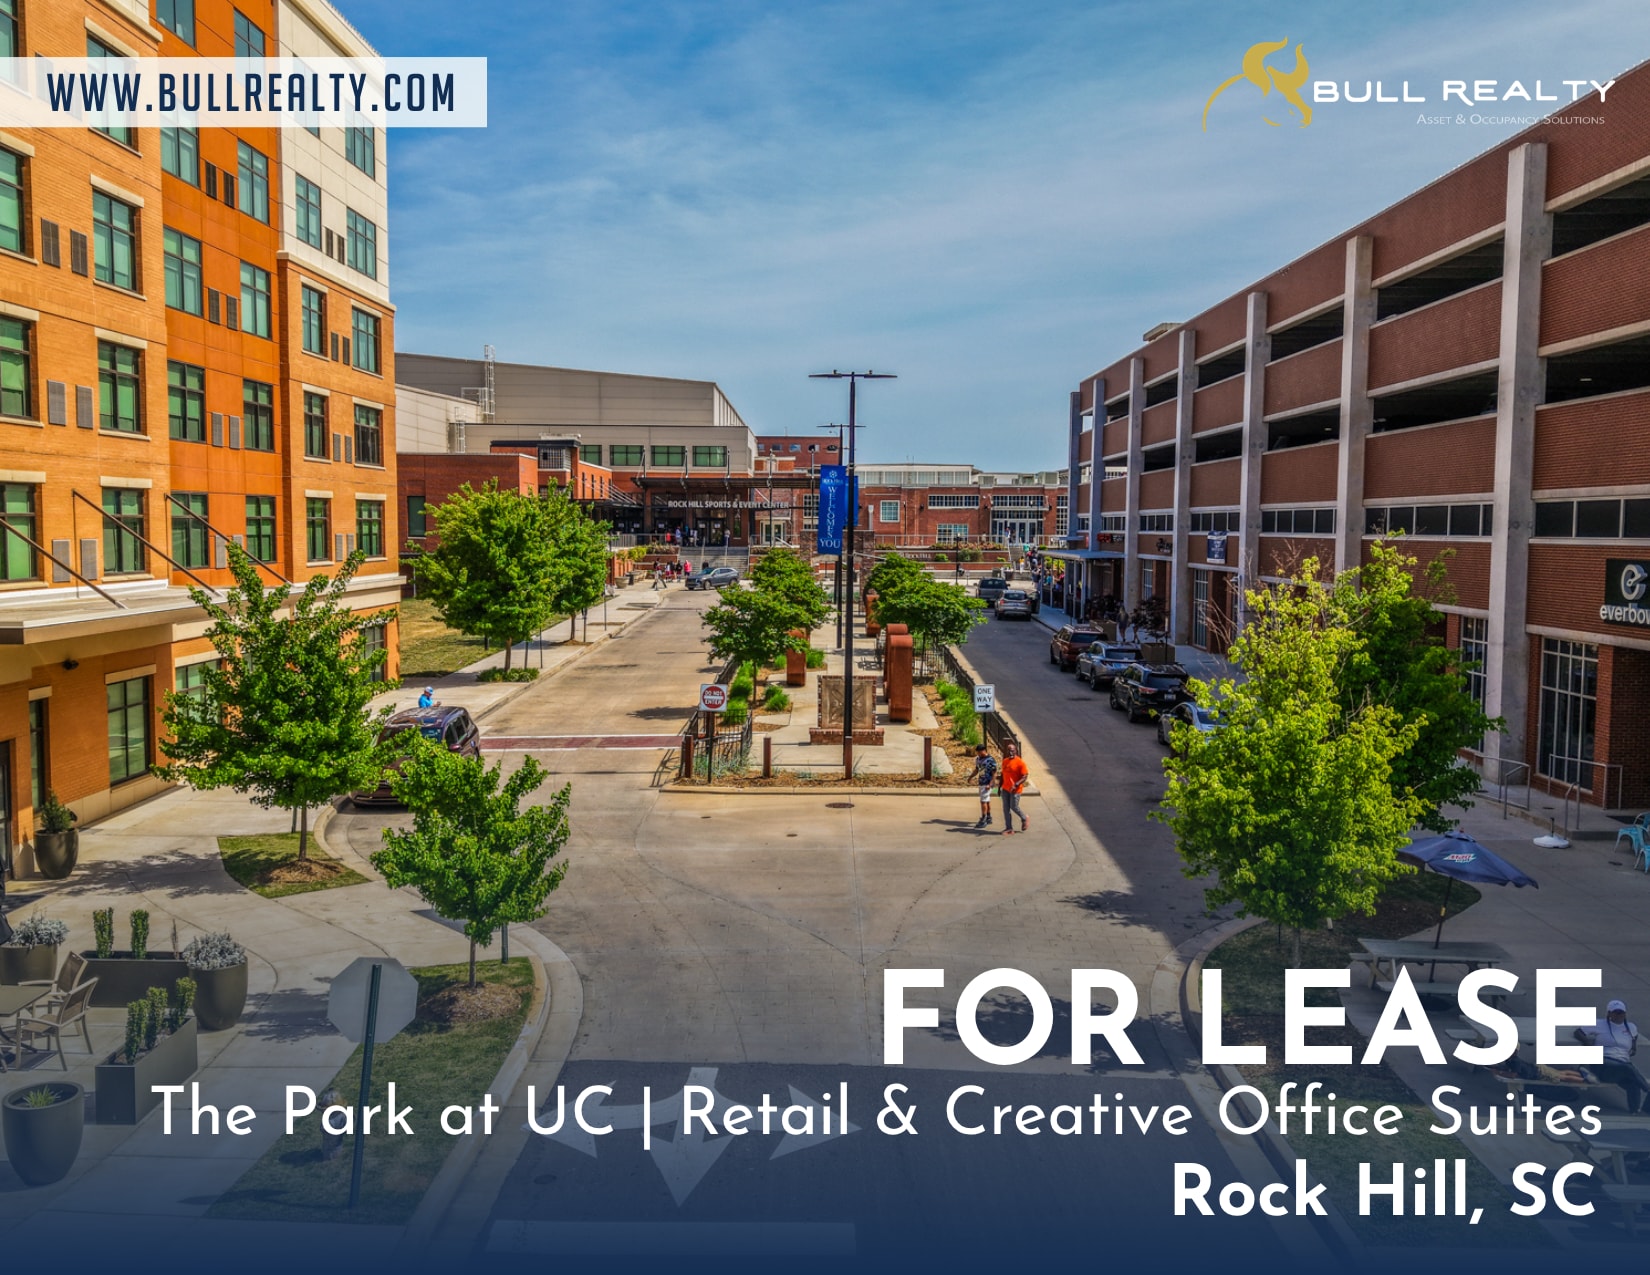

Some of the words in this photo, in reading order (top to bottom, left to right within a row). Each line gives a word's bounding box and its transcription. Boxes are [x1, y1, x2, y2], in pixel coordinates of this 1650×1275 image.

[668, 500, 687, 508] ROCK
[688, 500, 704, 508] HILL
[705, 500, 731, 508] SPORTS
[732, 500, 738, 508] &
[739, 500, 761, 508] EVENT
[820, 539, 841, 549] YOU
